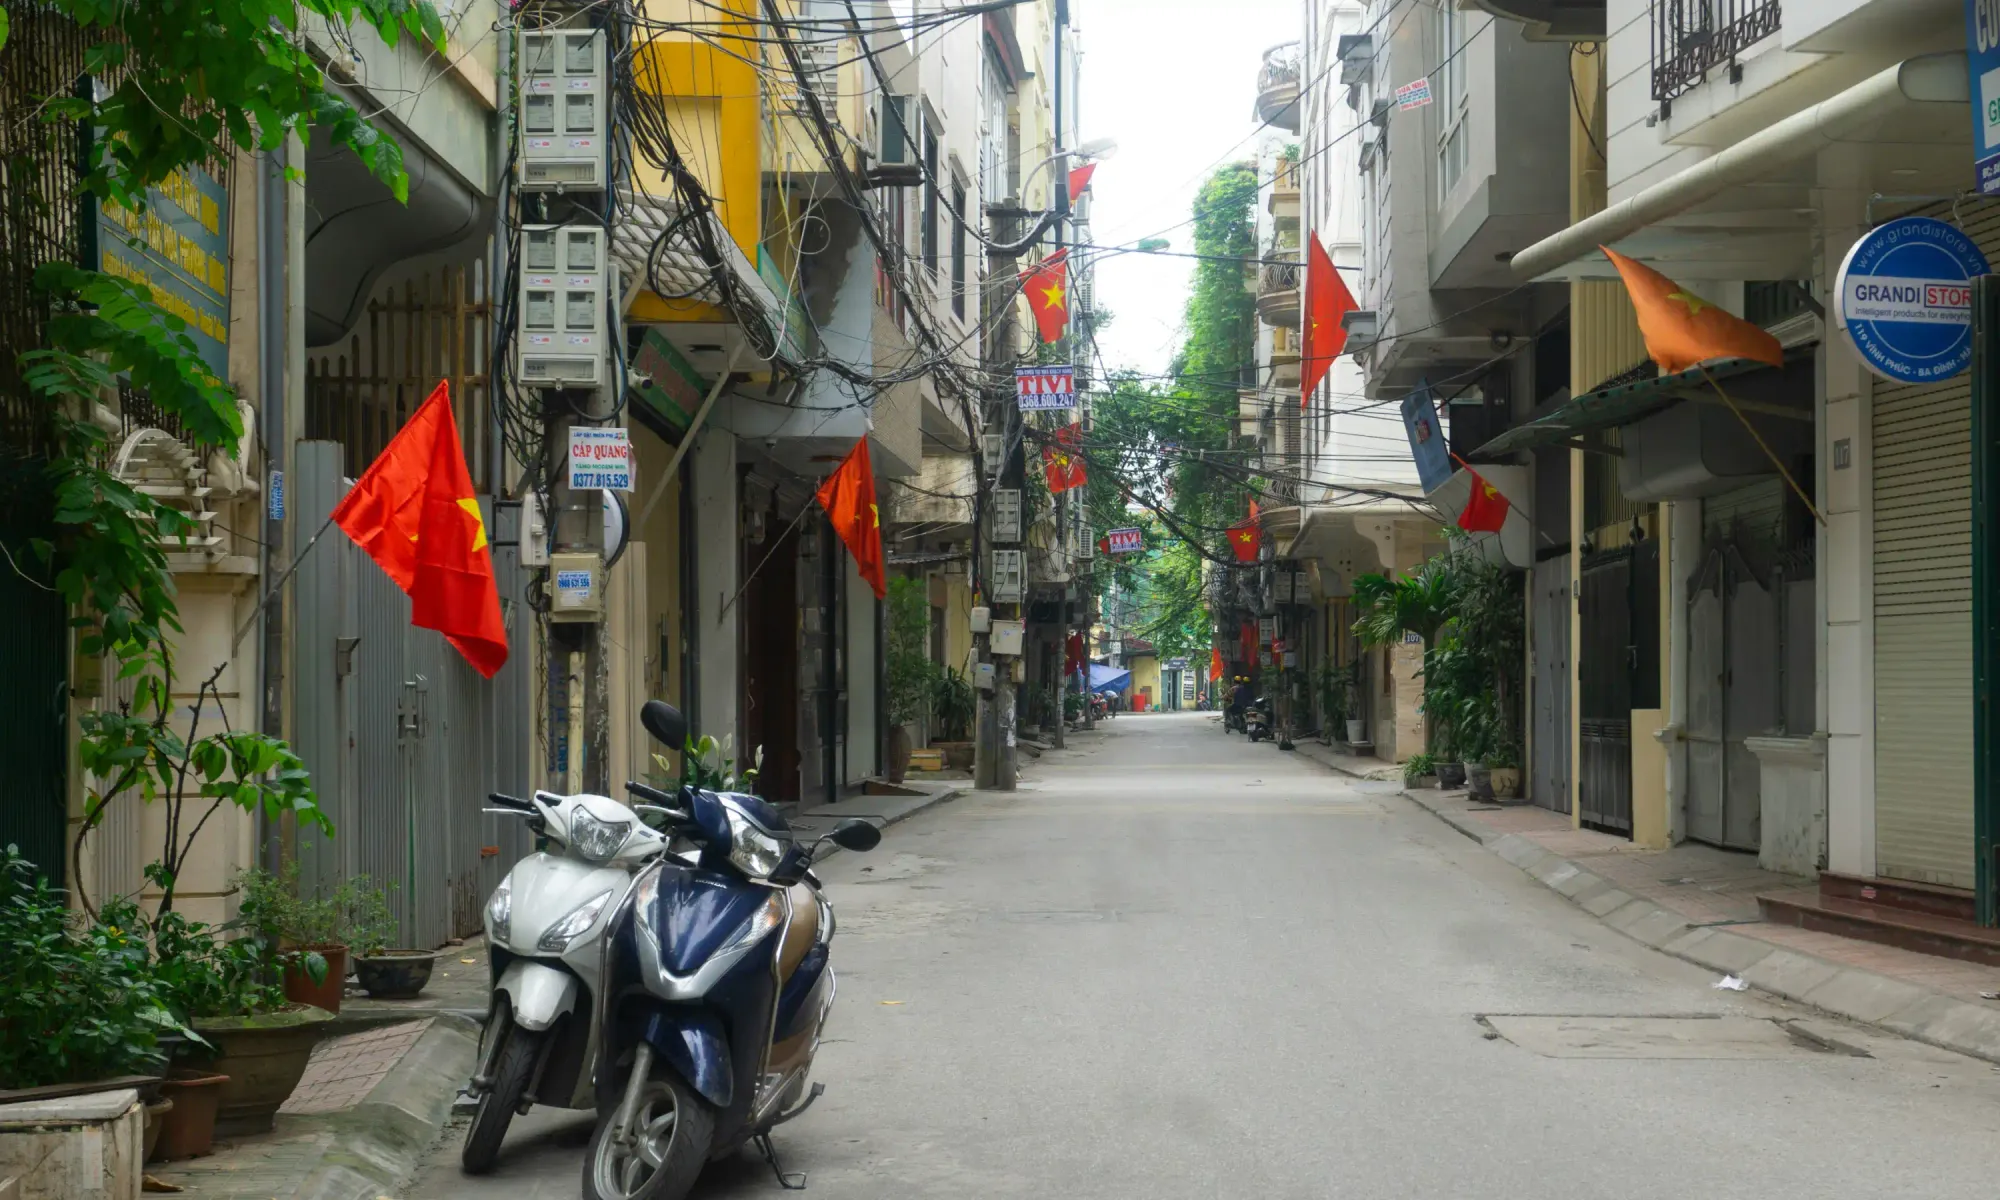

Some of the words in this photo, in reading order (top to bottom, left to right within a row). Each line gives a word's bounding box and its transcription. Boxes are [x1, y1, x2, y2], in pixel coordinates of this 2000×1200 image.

[1857, 223, 1982, 273] www.grandistore.vn
[1855, 284, 1920, 304] GRANDI
[1927, 287, 1971, 306] STOR
[1855, 307, 1892, 318] Intelligent
[1893, 309, 1926, 319] products
[1927, 310, 1938, 318] for
[1854, 323, 1868, 341] 119
[1885, 358, 1911, 375] PHÚC
[1917, 367, 1932, 377] BA
[1933, 358, 1956, 375] ĐÌNH
[1017, 375, 1073, 394] TIVI
[1018, 394, 1074, 408] 0368.600.247
[593, 444, 628, 460] QUANG
[1836, 444, 1849, 466] 117
[573, 472, 629, 488] 0377.815.529
[1110, 531, 1140, 545] TIVI
[1407, 634, 1419, 642] 107
